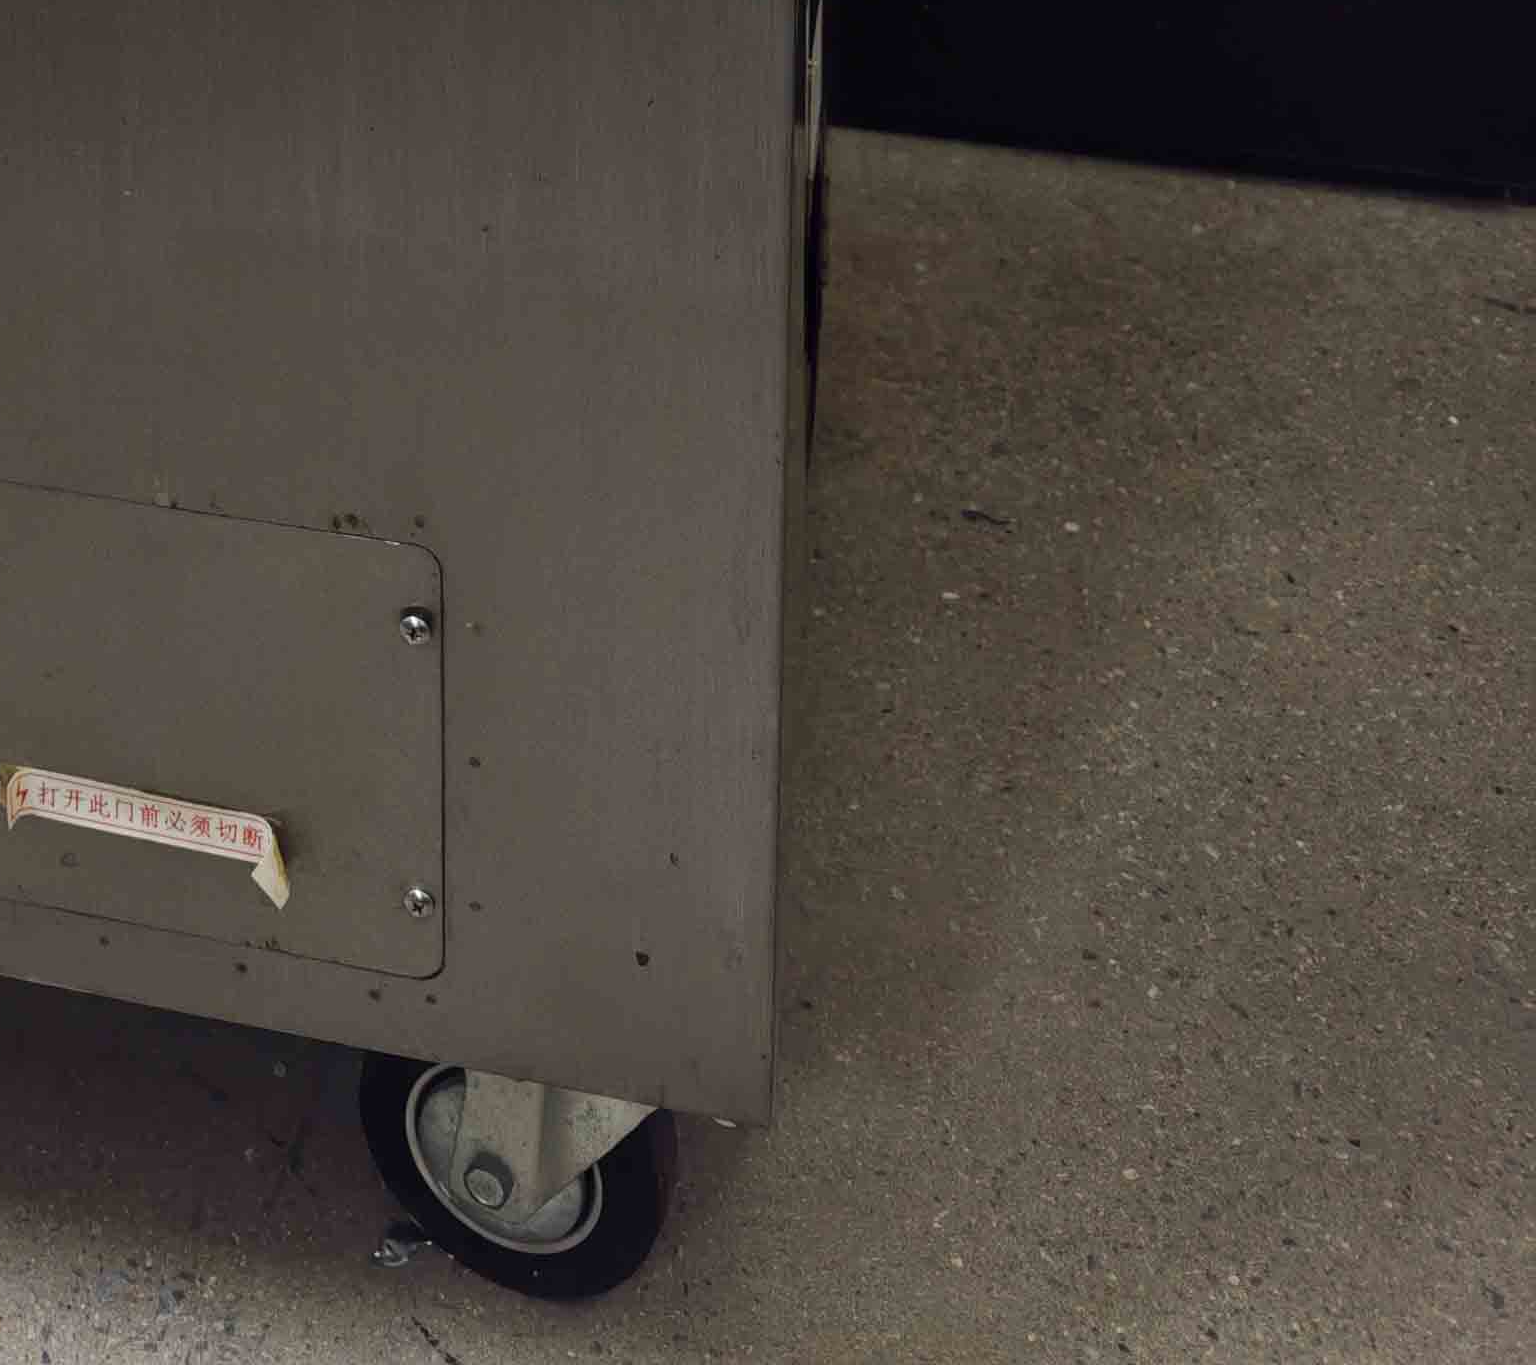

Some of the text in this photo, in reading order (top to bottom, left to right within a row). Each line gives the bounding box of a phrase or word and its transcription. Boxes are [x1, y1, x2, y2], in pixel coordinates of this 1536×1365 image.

[36, 781, 263, 850] 打开此门前必须切断
